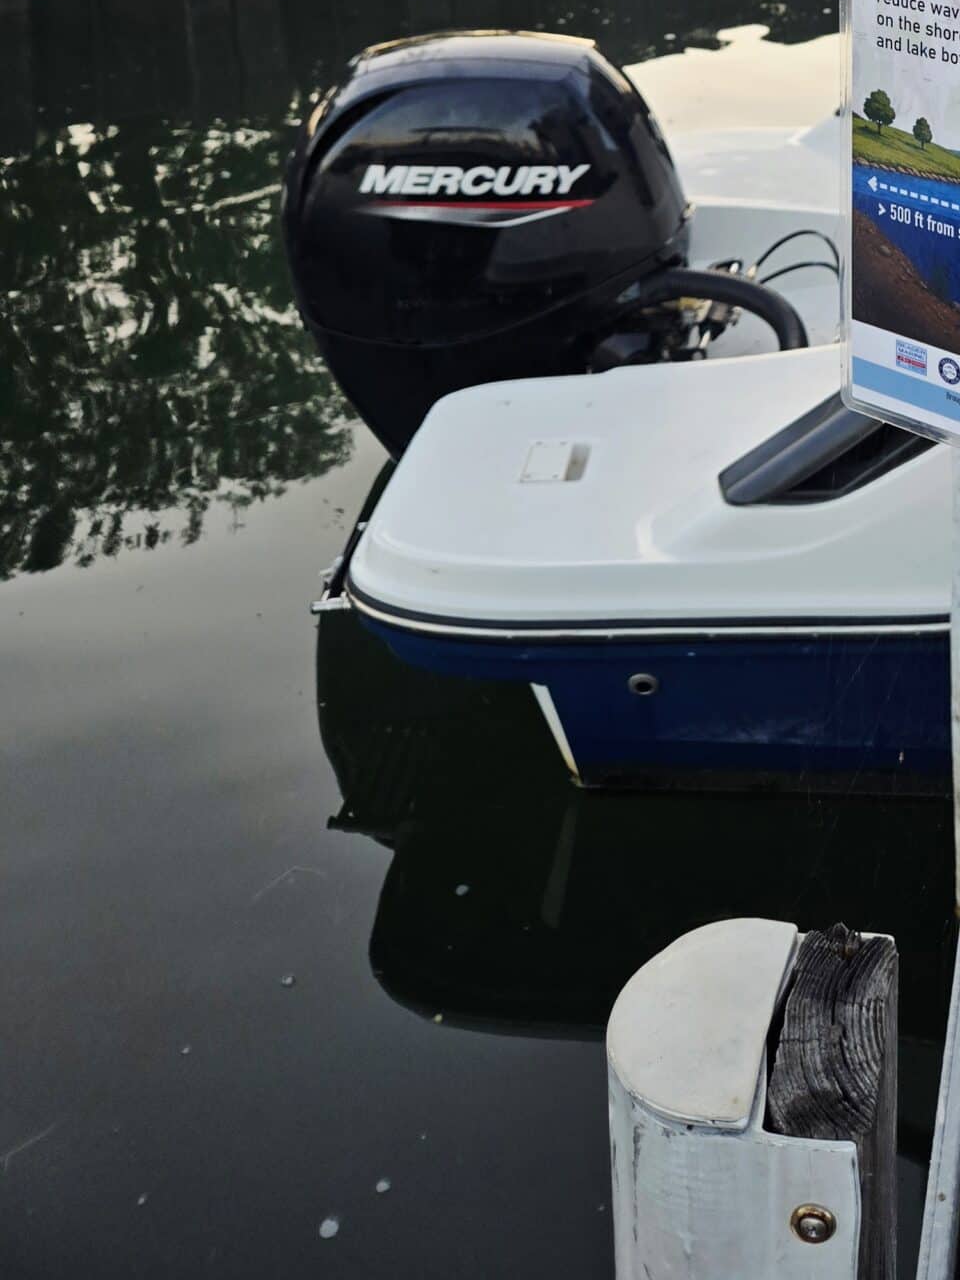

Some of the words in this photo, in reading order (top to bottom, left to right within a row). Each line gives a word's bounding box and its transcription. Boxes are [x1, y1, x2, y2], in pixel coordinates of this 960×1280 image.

[877, 15, 893, 27] on
[899, 16, 920, 33] the
[877, 37, 901, 51] and
[907, 39, 936, 59] lake
[360, 165, 589, 194] MERCURY
[891, 204, 910, 224] 500
[915, 212, 923, 228] ft
[927, 215, 954, 237] from
